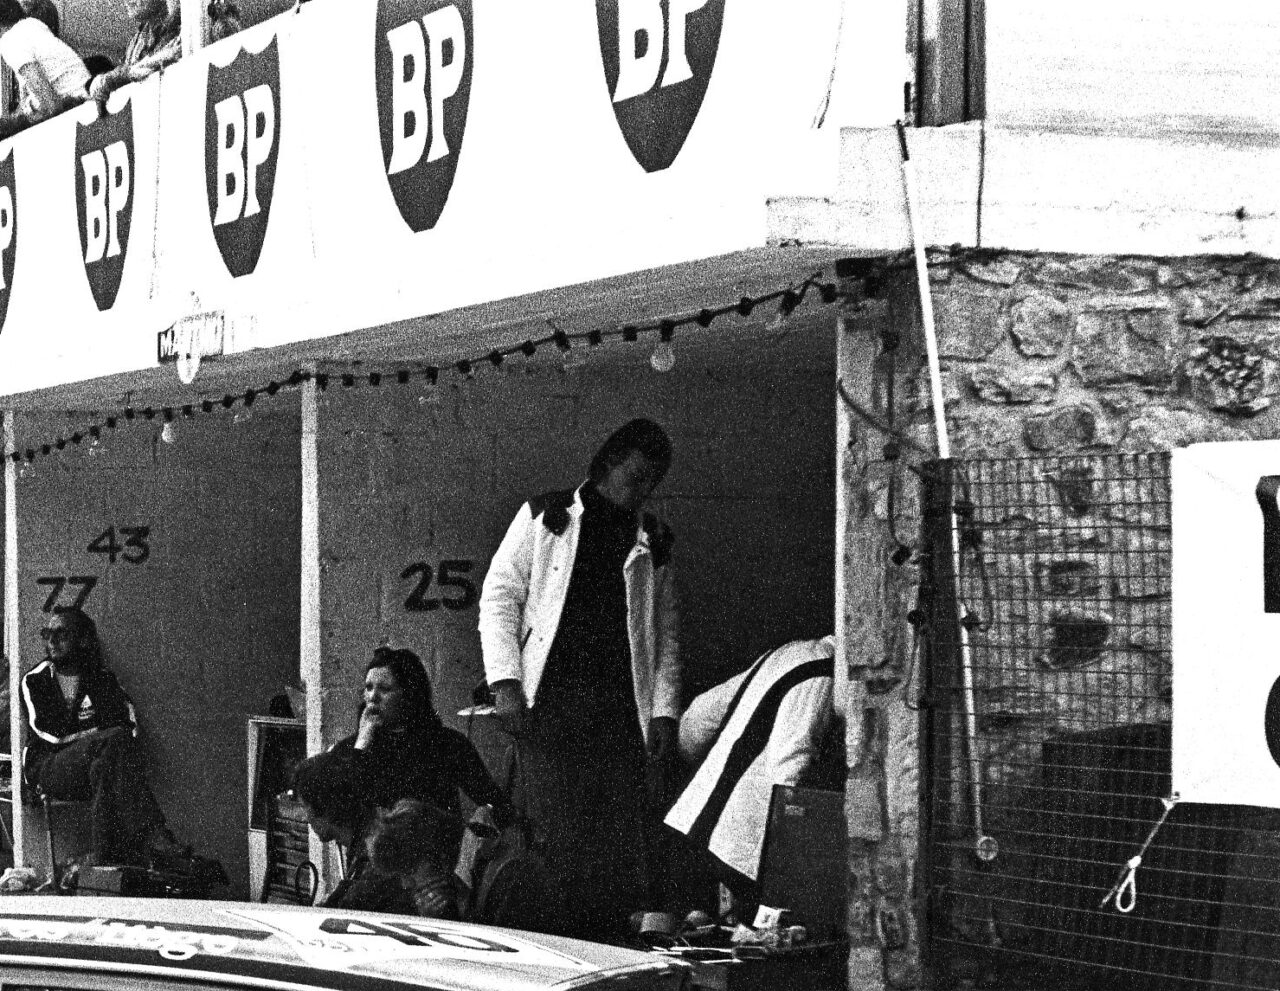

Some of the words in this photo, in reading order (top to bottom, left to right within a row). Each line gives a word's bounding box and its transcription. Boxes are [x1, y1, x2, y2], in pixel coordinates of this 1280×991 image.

[386, 4, 466, 175] BP
[612, 0, 712, 103] BP
[213, 83, 275, 226] BP
[80, 140, 129, 264] BP
[86, 526, 150, 564] 43
[37, 576, 98, 612] 77
[400, 559, 477, 612] 25
[319, 917, 520, 953] 46
